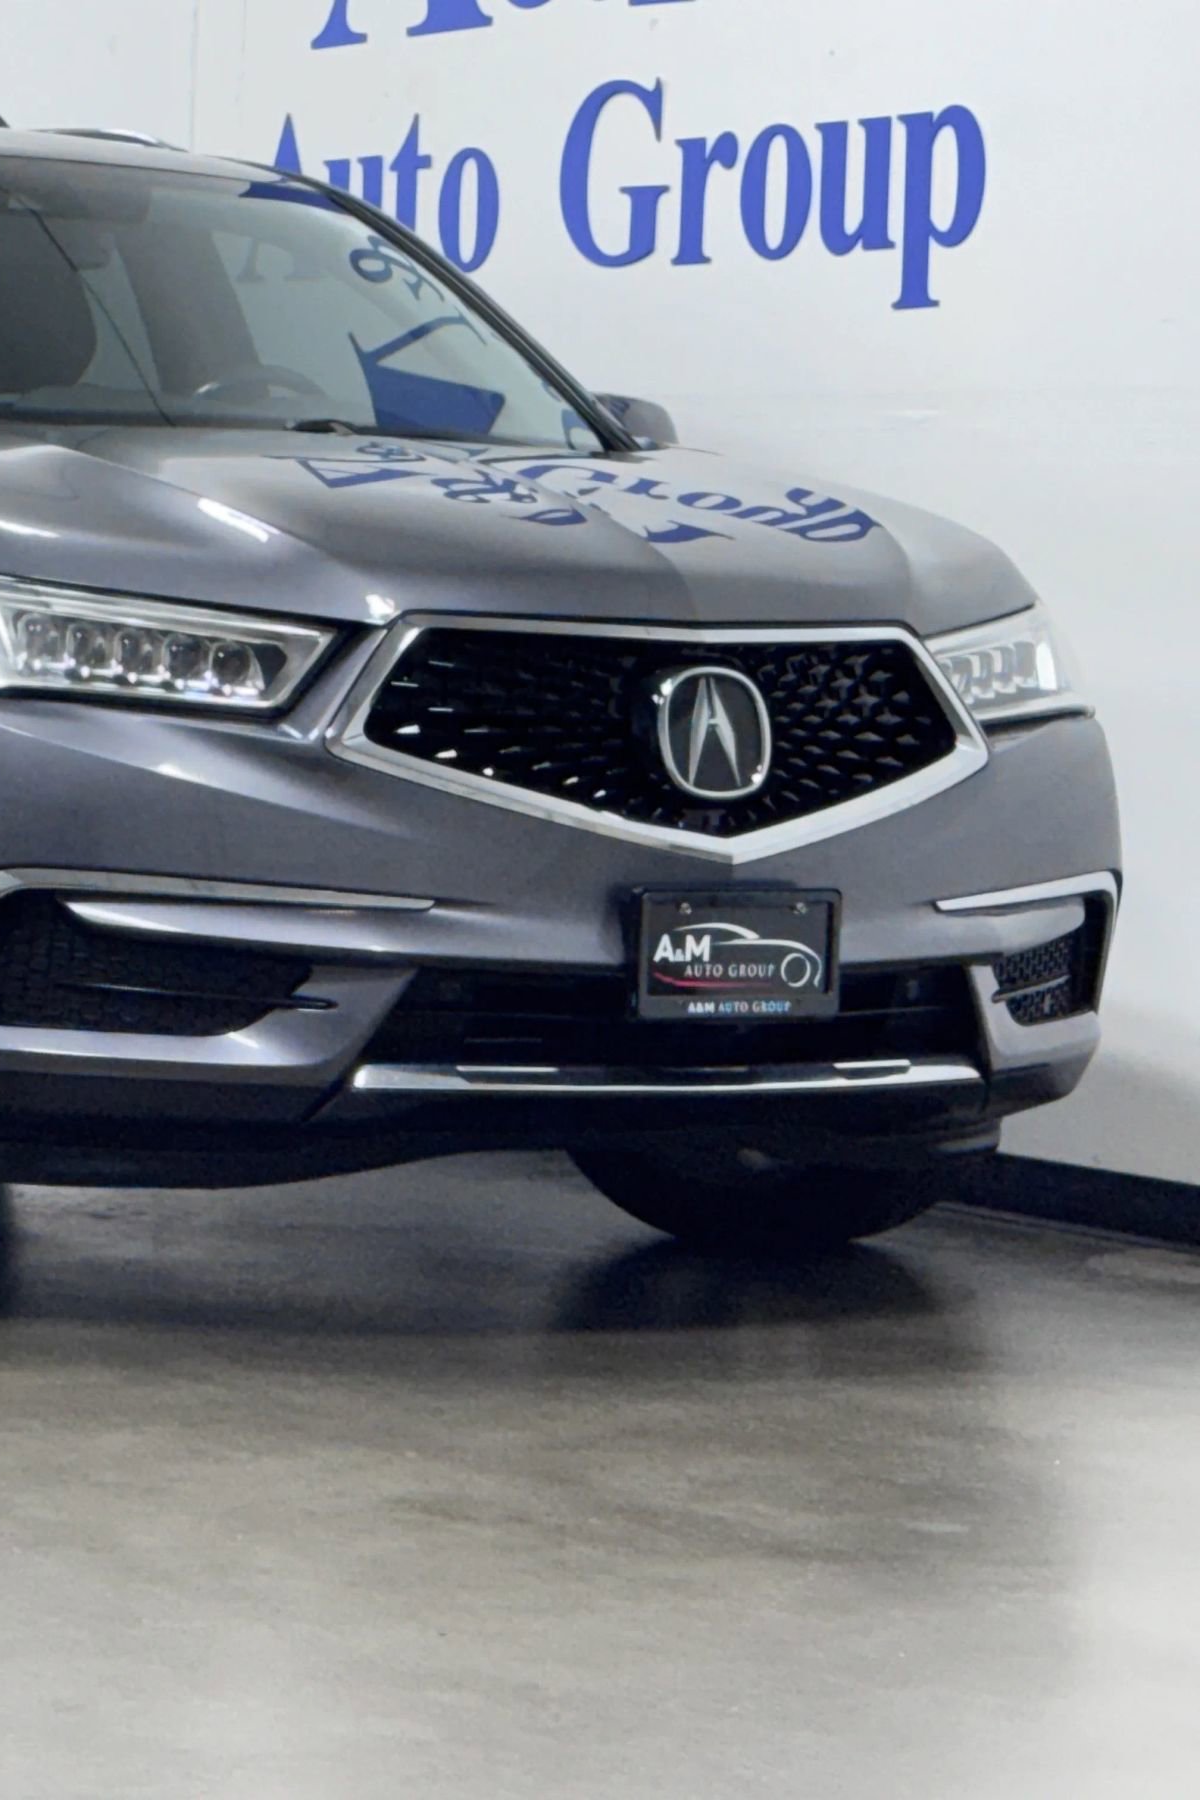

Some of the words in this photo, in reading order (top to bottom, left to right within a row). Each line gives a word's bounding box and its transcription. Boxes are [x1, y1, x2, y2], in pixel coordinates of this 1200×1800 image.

[559, 76, 987, 310] Group
[653, 933, 712, 962] A&M
[684, 963, 724, 978] AUTO
[727, 963, 776, 978] GROUP
[718, 1001, 749, 1014] AUTO
[752, 1001, 792, 1014] GROUP
